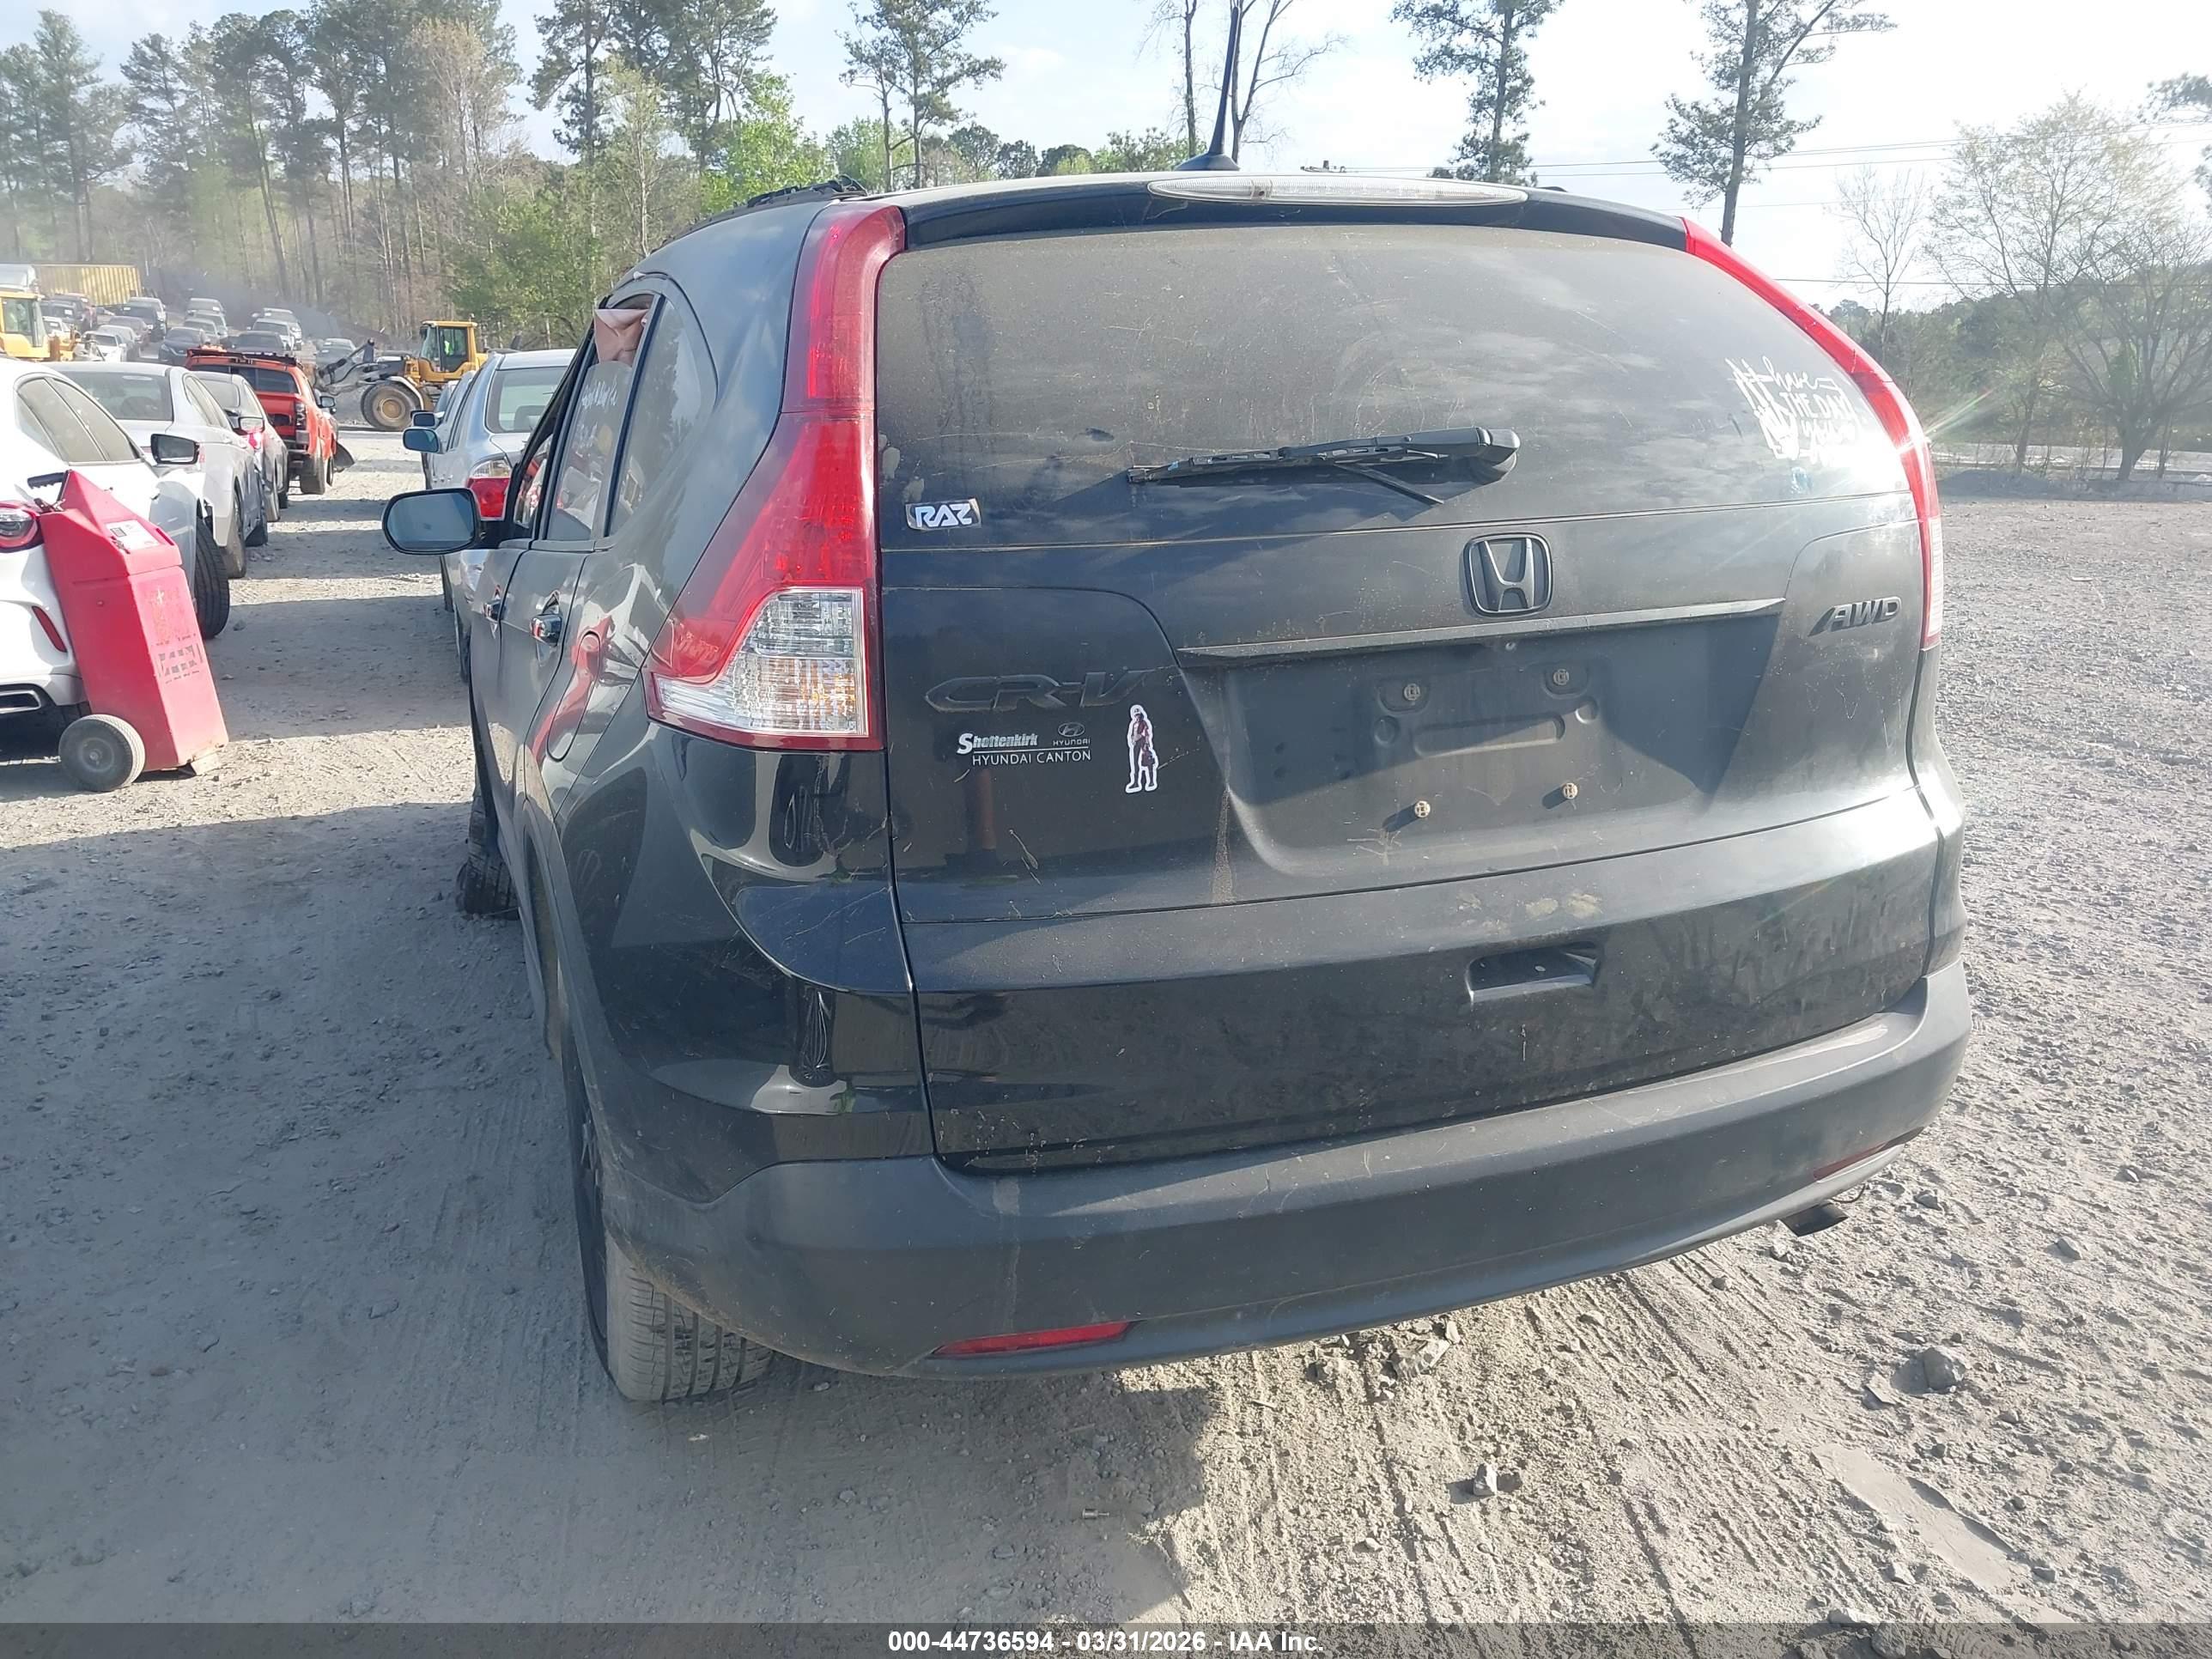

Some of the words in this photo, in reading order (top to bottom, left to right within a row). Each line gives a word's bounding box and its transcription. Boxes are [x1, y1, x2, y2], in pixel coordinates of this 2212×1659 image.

[1779, 392, 1818, 419] THE
[915, 502, 973, 527] RAZ
[1808, 596, 1902, 636] AWD
[925, 672, 1146, 713] CR-V
[1052, 738, 1091, 746] HYUNDAI
[972, 753, 1032, 767] HYUNDAI
[1036, 750, 1091, 763] CANTON
